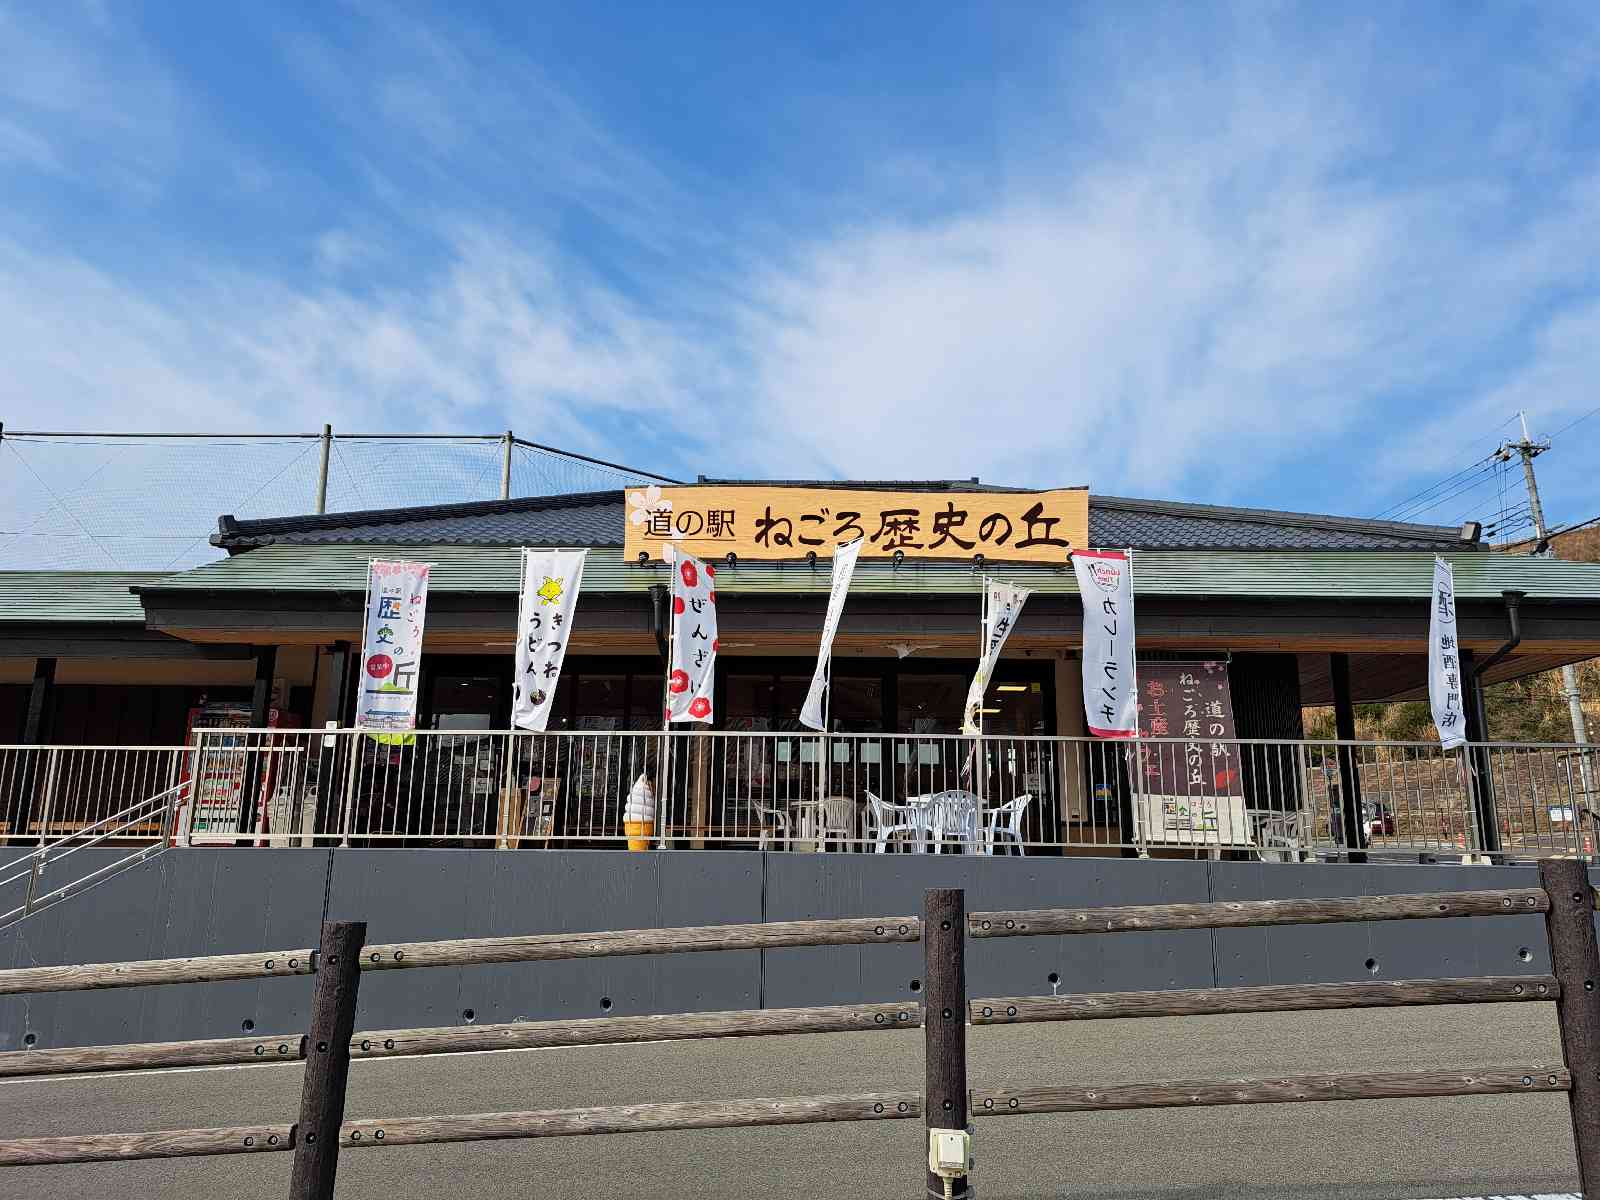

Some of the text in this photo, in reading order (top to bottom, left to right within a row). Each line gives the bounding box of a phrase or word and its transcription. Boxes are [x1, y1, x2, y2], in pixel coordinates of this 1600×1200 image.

[643, 501, 1072, 552] 道の駅 ねごろ歴史の丘
[526, 611, 542, 677] うどん
[543, 612, 564, 679] きつね
[688, 597, 709, 695] ぜんざい
